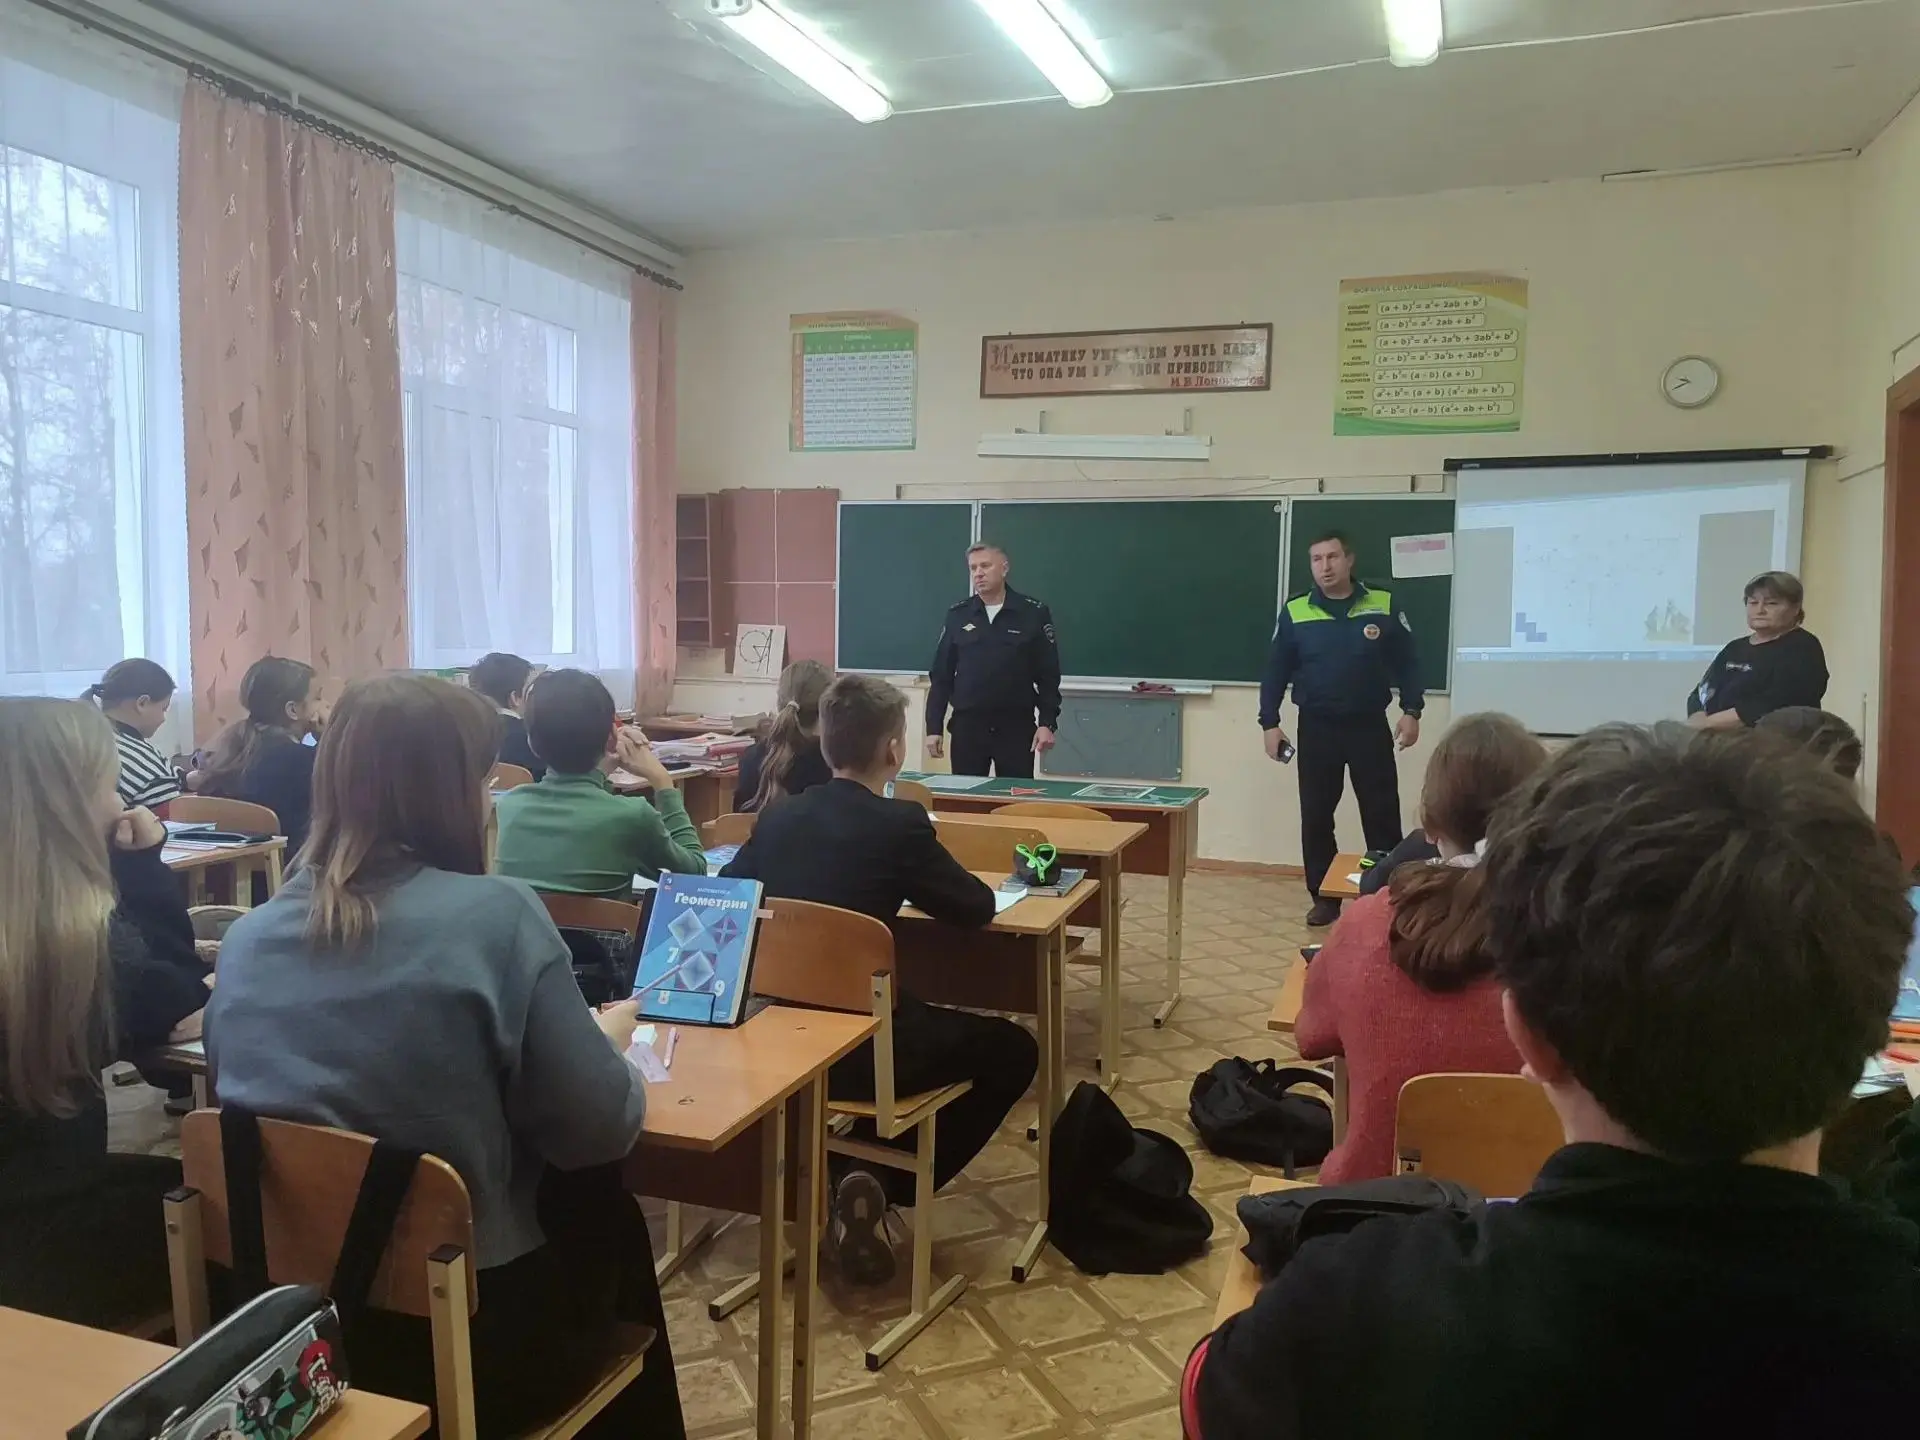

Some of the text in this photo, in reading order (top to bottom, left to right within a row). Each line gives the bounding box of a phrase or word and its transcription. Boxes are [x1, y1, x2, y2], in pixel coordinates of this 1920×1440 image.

[1174, 344, 1216, 357] УЧИТЬ
[1011, 367, 1033, 380] ЧТО
[1068, 365, 1086, 378] УМ
[674, 892, 748, 910] Геометрия
[667, 947, 679, 964] 7
[714, 980, 726, 997] 9
[657, 990, 670, 1005] 8
